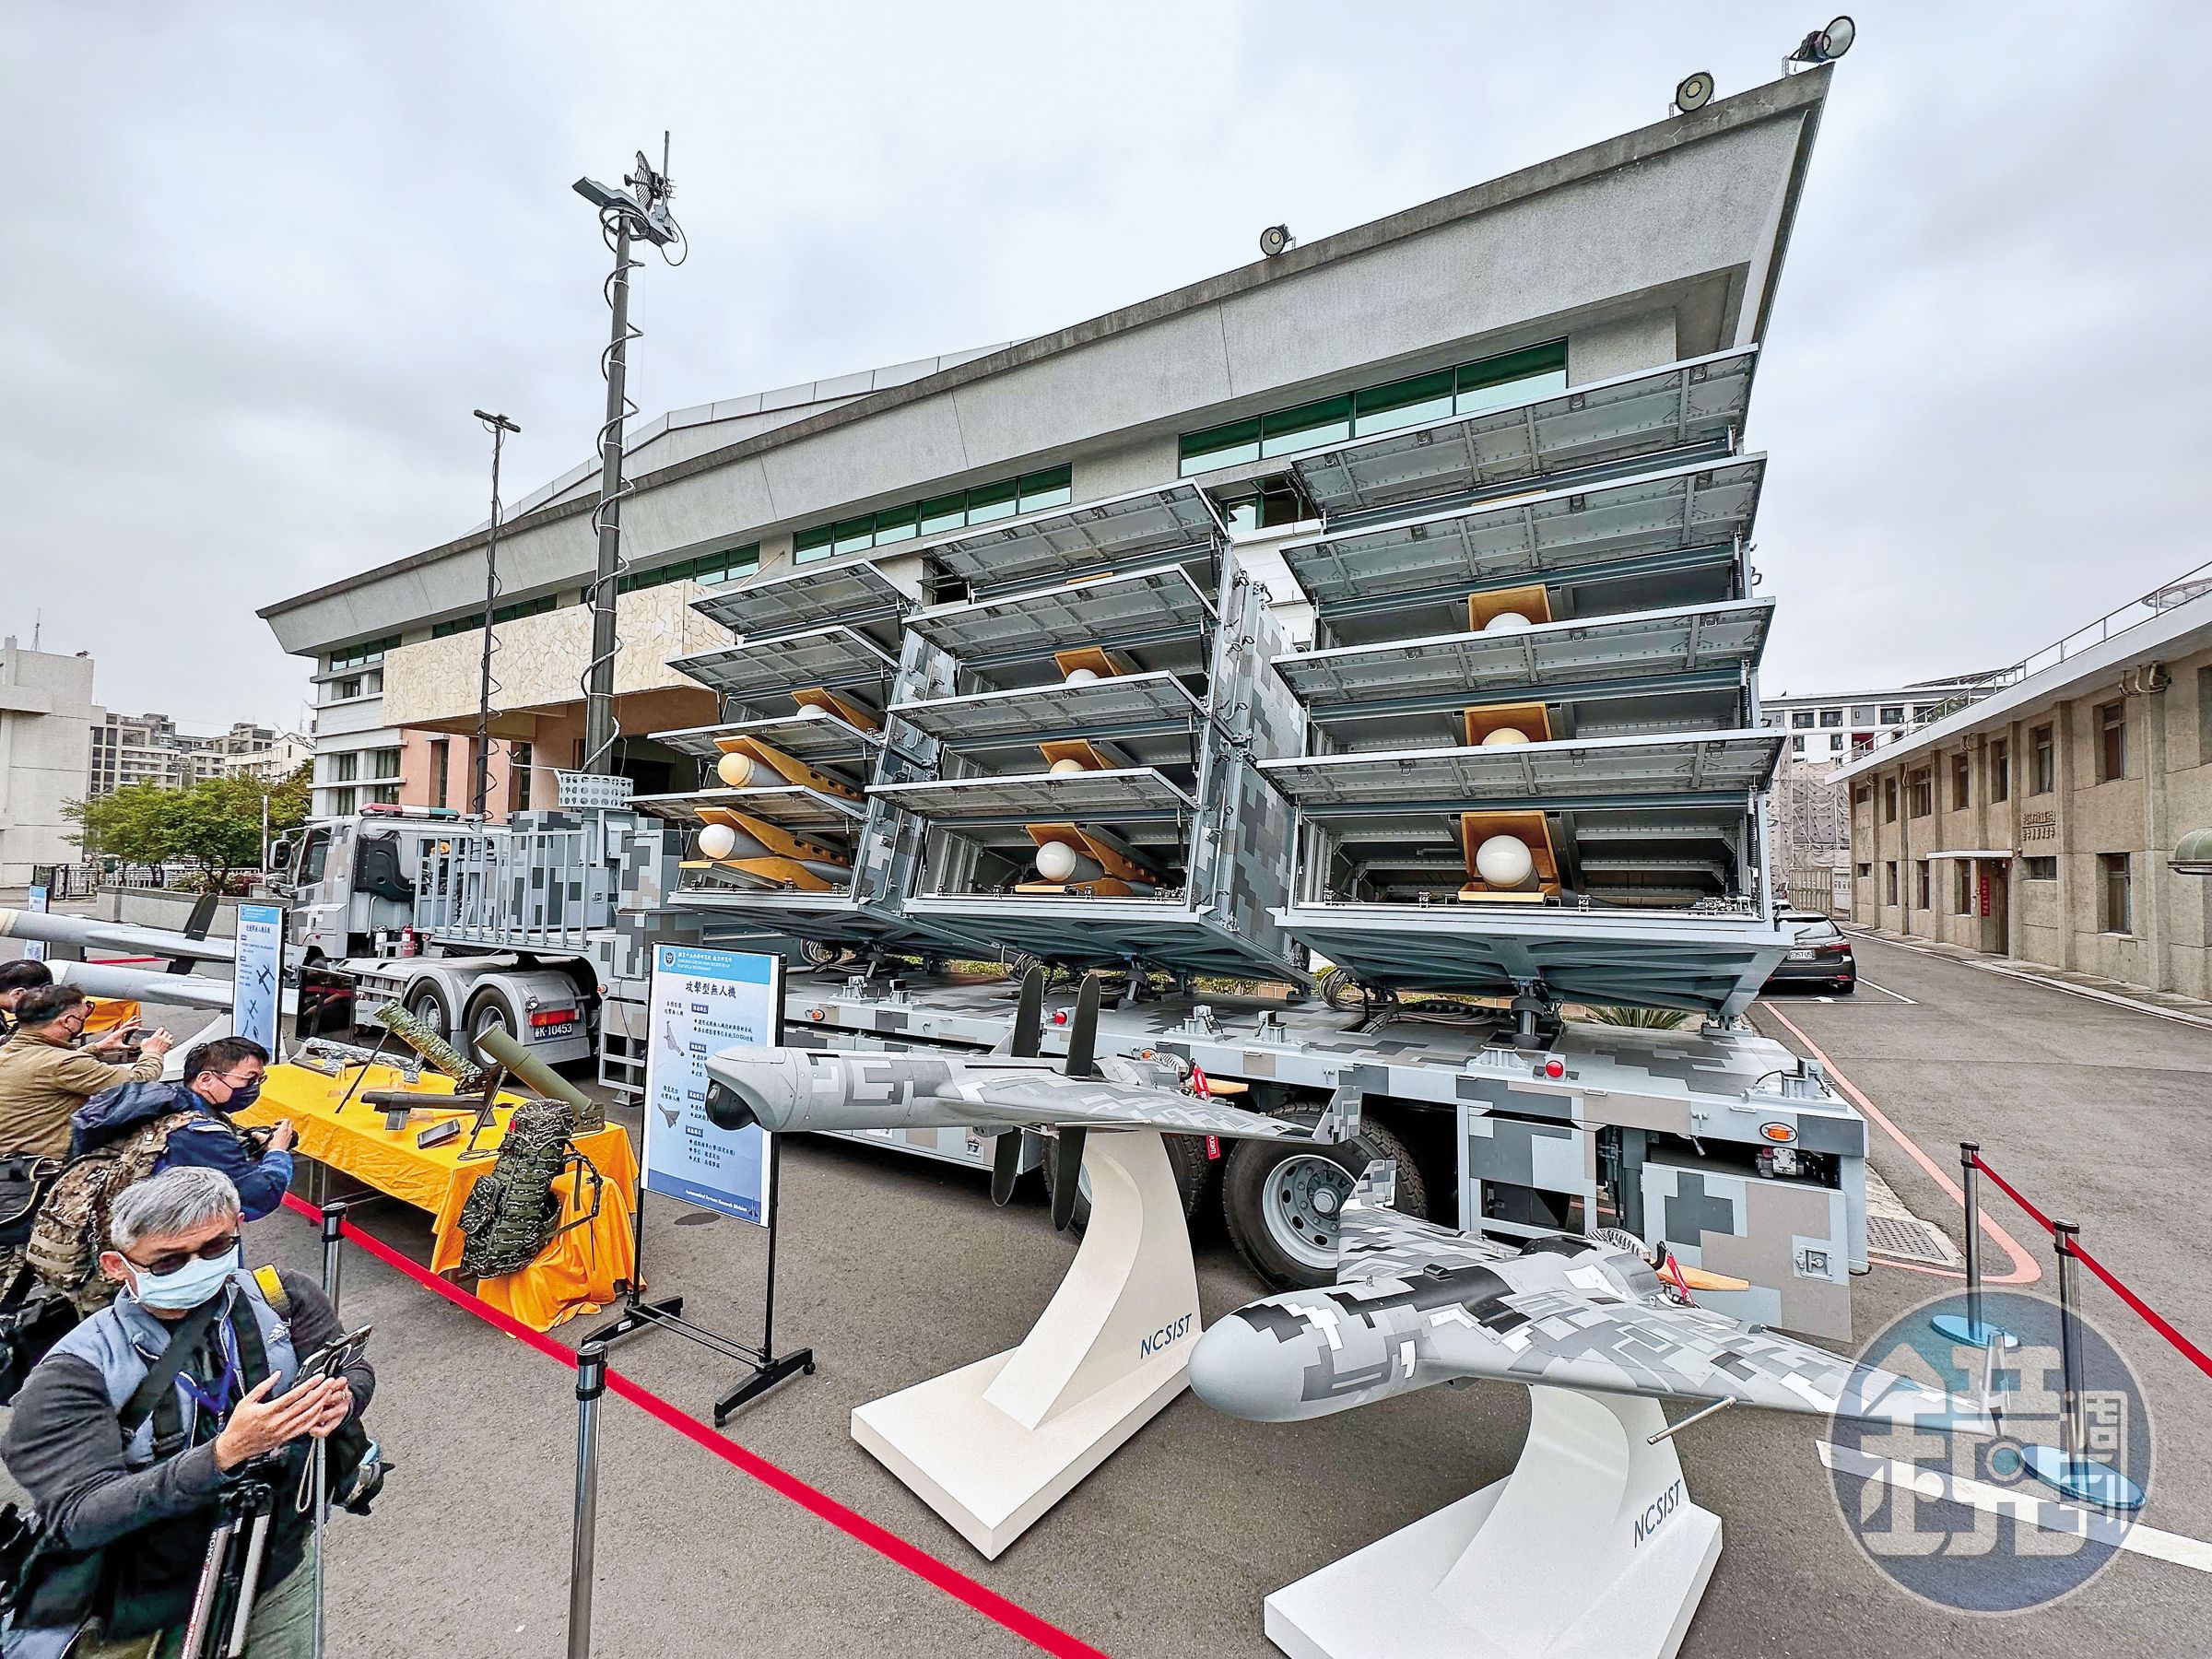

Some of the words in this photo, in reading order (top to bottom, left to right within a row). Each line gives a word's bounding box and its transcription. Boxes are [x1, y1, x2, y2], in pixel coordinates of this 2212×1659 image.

[686, 981, 736, 998] 攻擊型無人機
[1140, 1312, 1192, 1359] NCSIST
[1634, 1478, 1681, 1548] NCSIST
